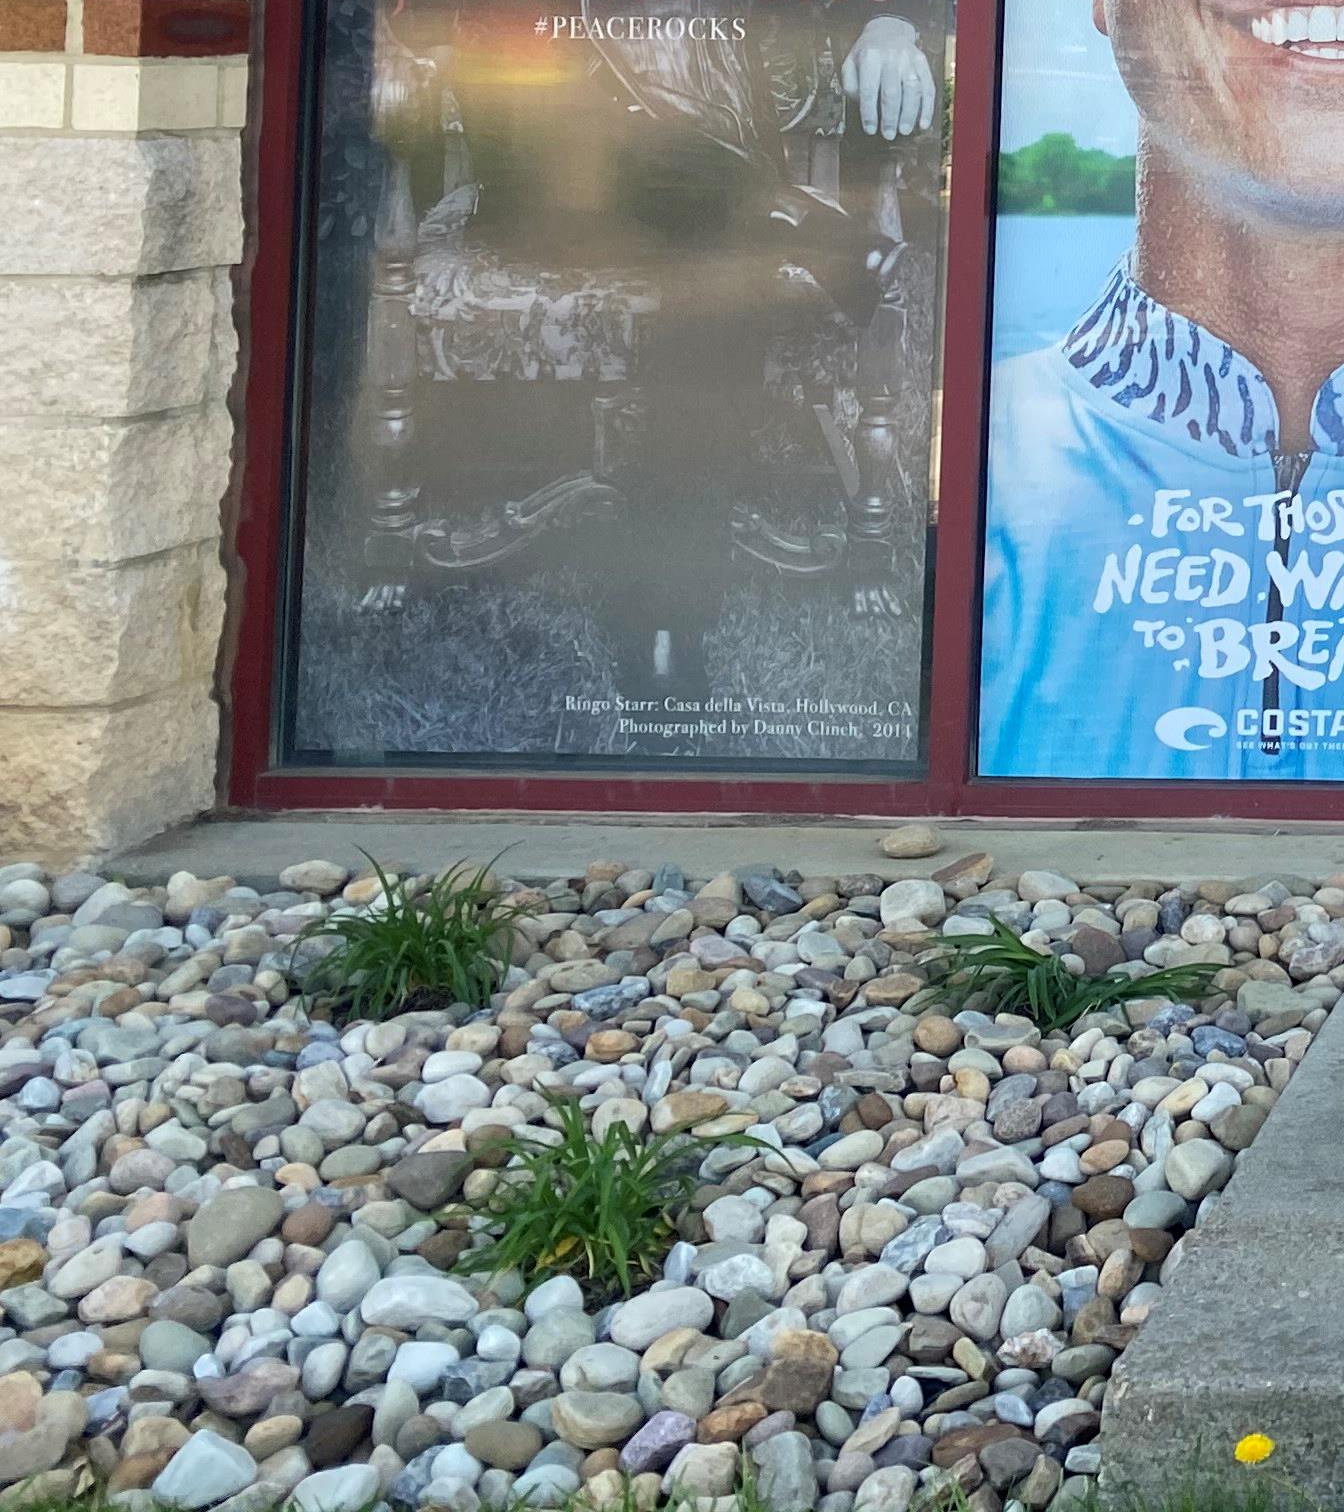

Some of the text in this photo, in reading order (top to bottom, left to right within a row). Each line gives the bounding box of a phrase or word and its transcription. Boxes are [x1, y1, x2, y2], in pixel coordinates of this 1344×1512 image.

[533, 14, 747, 43] #PEACEROCKS
[1150, 488, 1245, 539] FOR
[1092, 543, 1251, 614] NEED
[1132, 618, 1187, 651] TO
[565, 694, 611, 716] Ringo
[614, 695, 659, 712] Starr:
[663, 695, 700, 712] Casa
[704, 696, 742, 713] della
[887, 700, 913, 717] CA
[618, 717, 727, 738] Photographed
[731, 719, 749, 738] by
[753, 719, 803, 739] Danny
[1235, 741, 1255, 750] SEE
